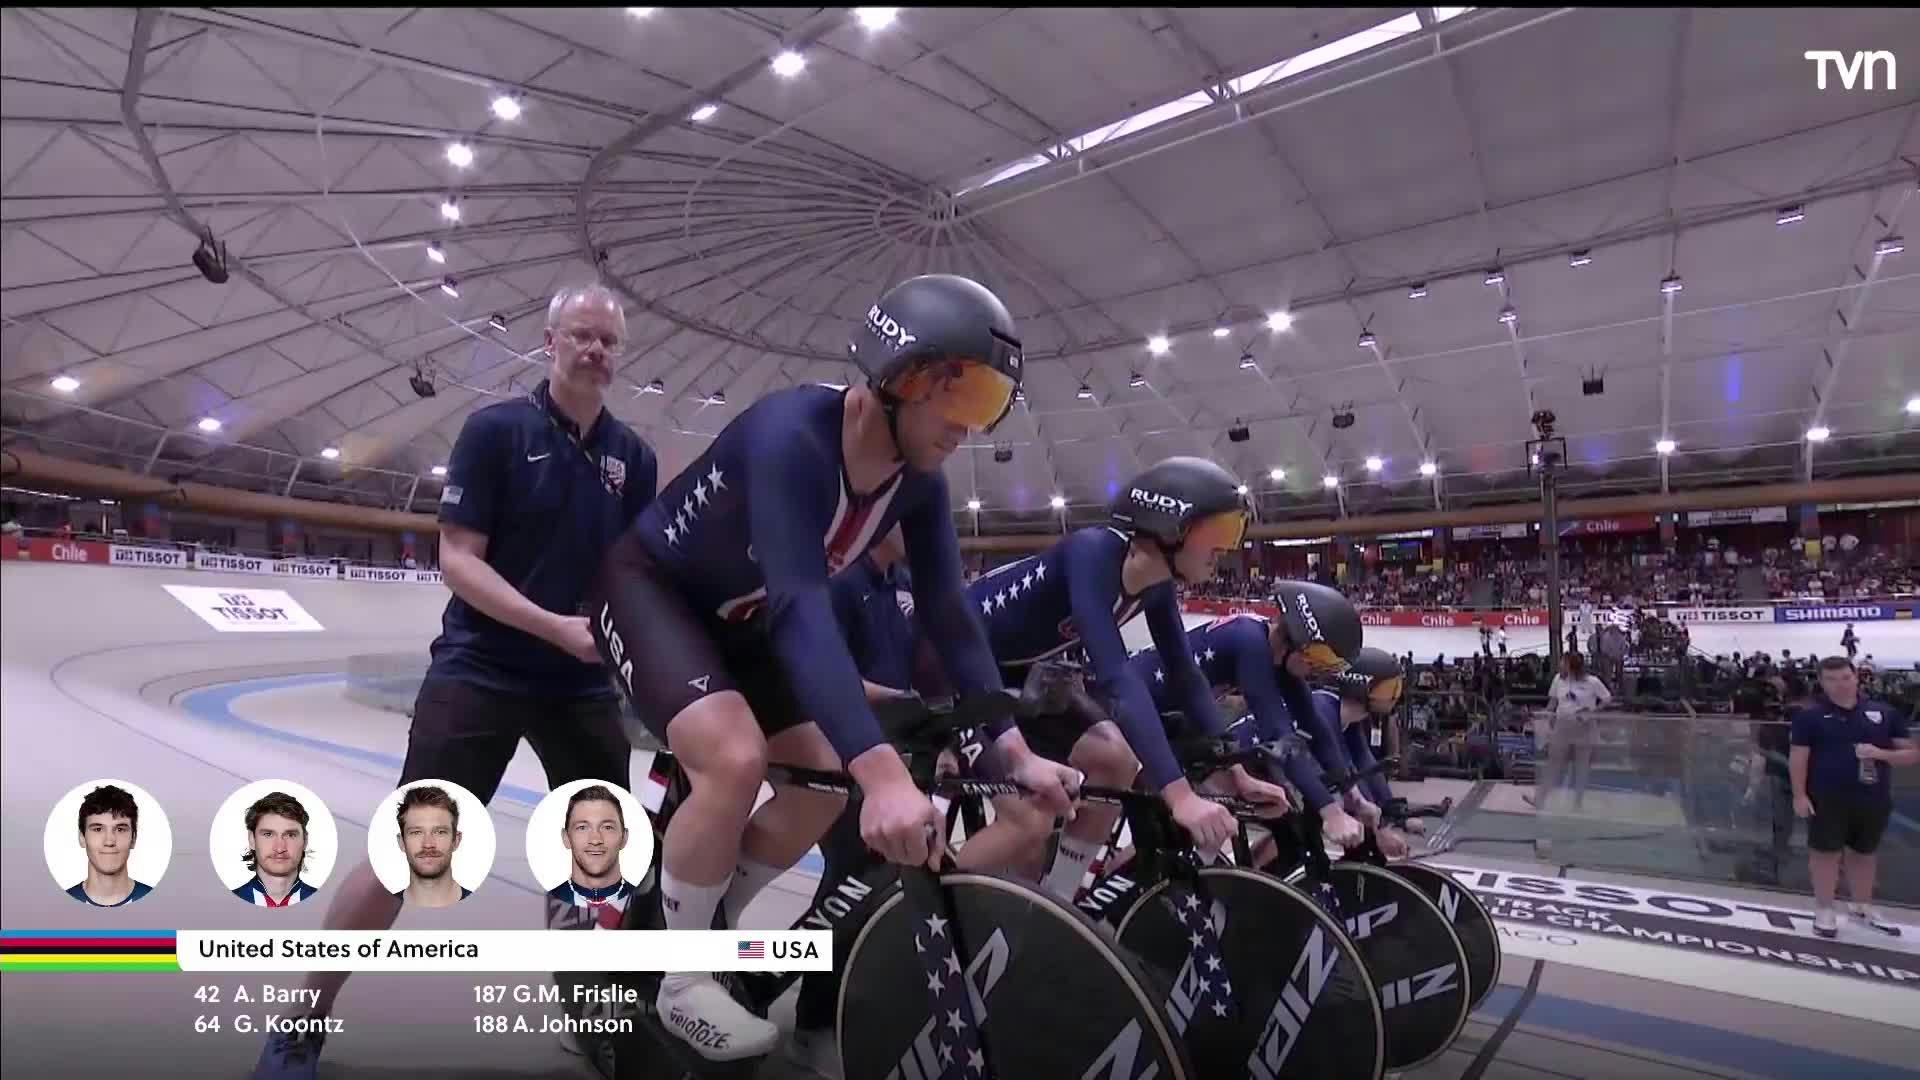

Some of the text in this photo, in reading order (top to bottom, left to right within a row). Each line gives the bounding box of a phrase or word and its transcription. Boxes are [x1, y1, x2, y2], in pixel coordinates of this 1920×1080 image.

[868, 304, 917, 346] RUDY
[1130, 487, 1193, 514] RUDY
[52, 543, 88, 562] Chile
[135, 551, 181, 565] TISSOT
[220, 557, 263, 572] TISSOT
[291, 563, 332, 577] TISSOT
[368, 569, 407, 581] TISSOT
[211, 606, 289, 621] TISSOT
[1297, 593, 1325, 641] RUDY
[1360, 612, 1392, 626] Chile
[1421, 613, 1455, 627] Chile
[1504, 612, 1540, 626] Chile
[1702, 610, 1765, 621] TISSOT
[1785, 604, 1881, 622] SHIMANO
[600, 600, 634, 697] USA
[1076, 873, 1136, 912] YON
[806, 875, 873, 930] YON
[1498, 898, 1612, 922] TRACK
[1547, 914, 1920, 981] CHAMPIONSHIP
